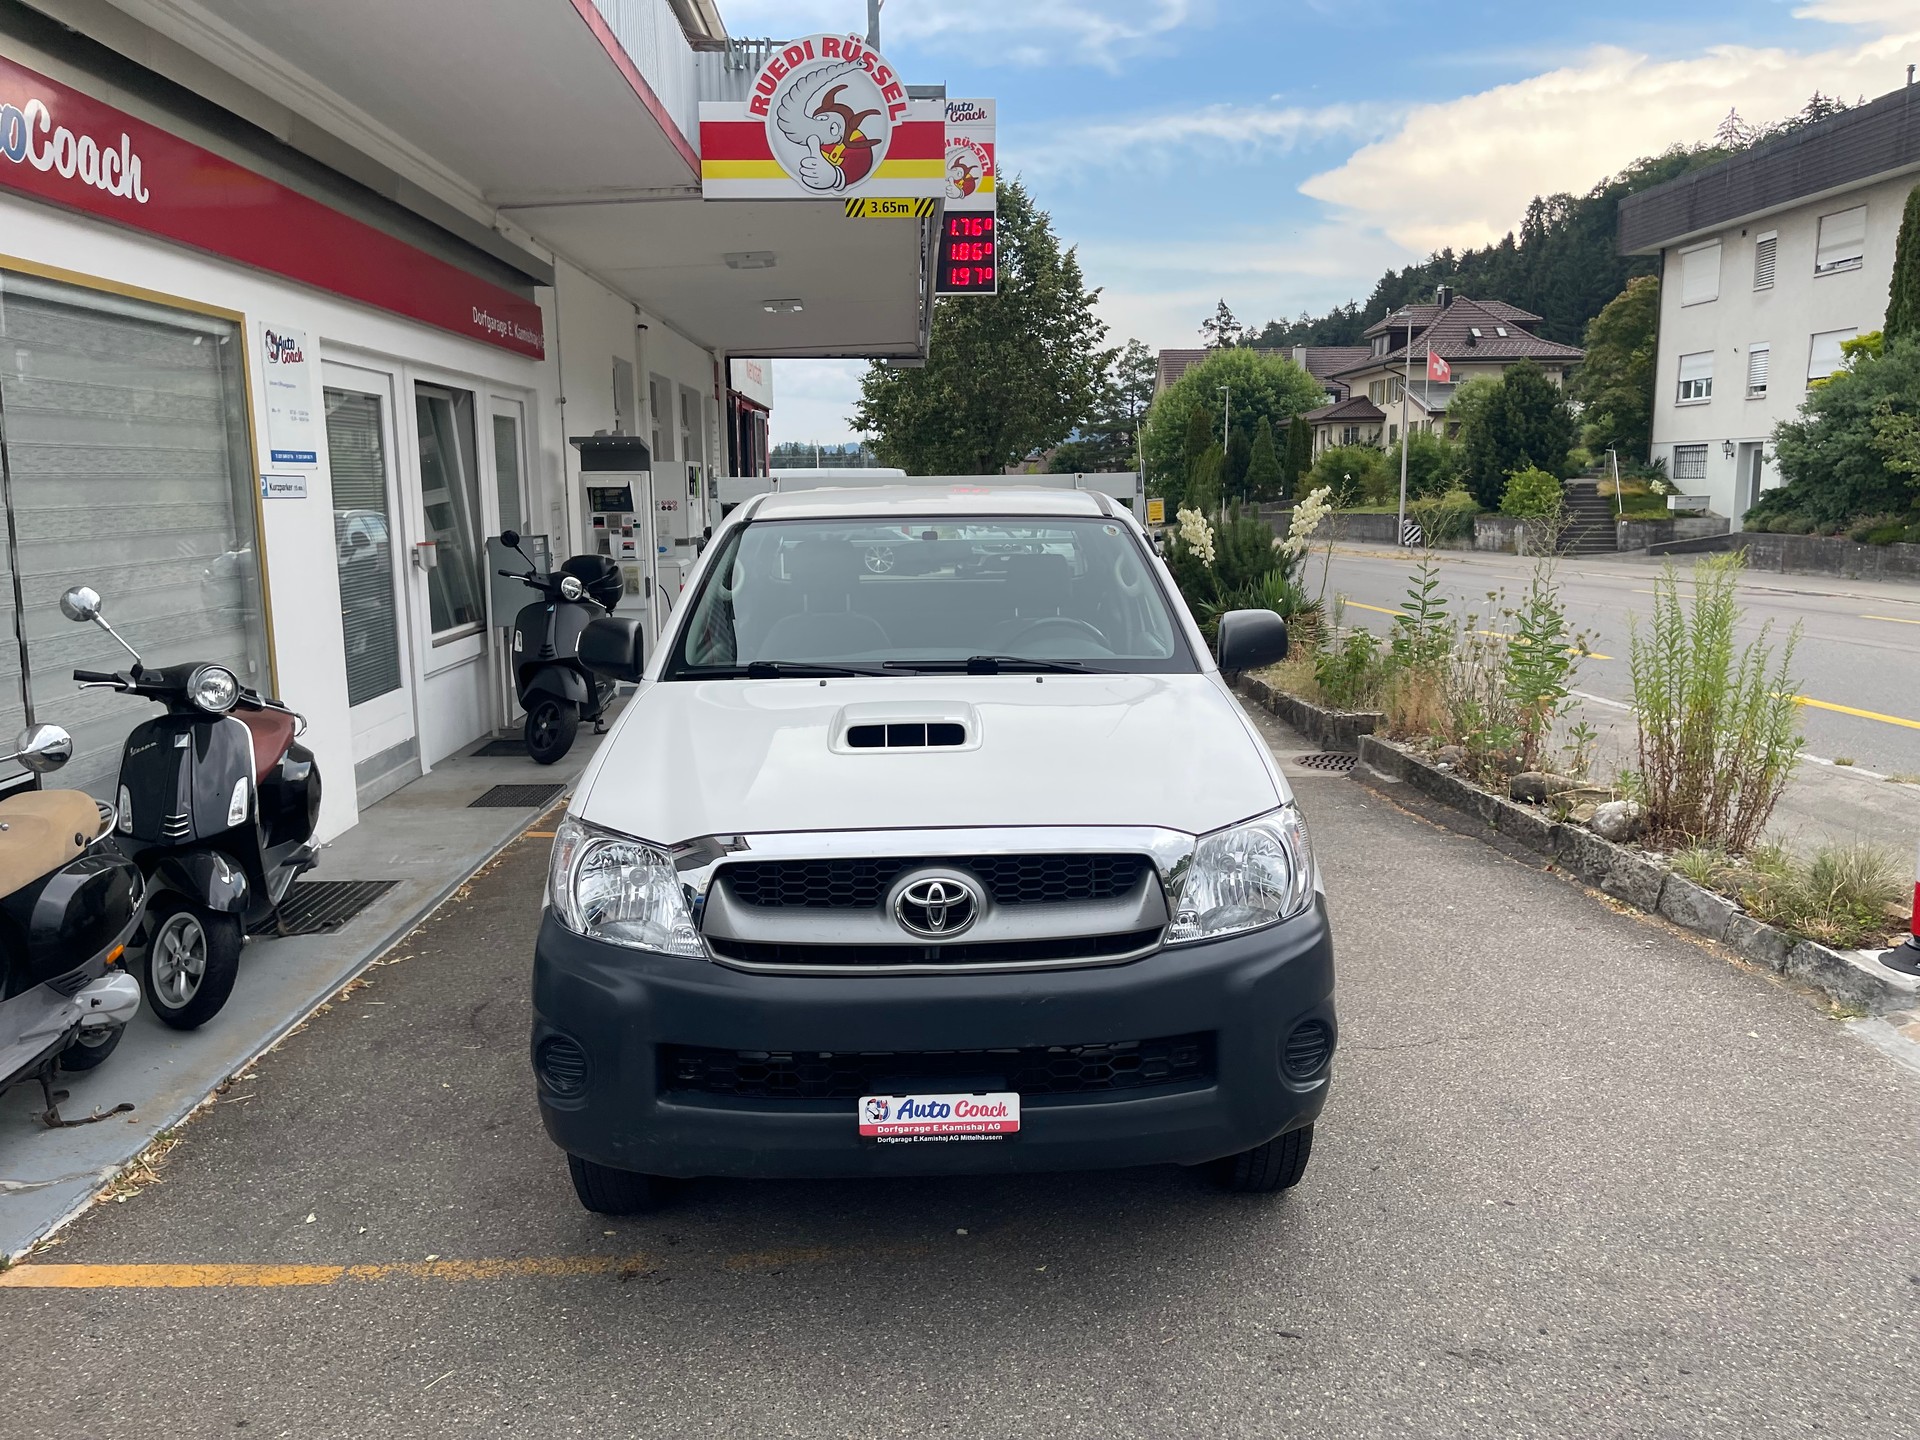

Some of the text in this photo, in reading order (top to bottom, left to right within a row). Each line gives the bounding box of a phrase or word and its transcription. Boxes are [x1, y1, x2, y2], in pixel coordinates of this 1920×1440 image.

[750, 35, 907, 121] RUEDI RÜSSEL
[945, 102, 974, 118] Auto
[950, 108, 987, 122] Coach
[954, 136, 989, 170] RÜSSEL
[871, 201, 909, 213] 3.65m
[278, 335, 295, 350] Auto
[281, 347, 304, 364] Coach
[897, 1099, 1008, 1120] Auto Coach
[877, 1126, 931, 1134] Dorfgarage
[877, 1136, 912, 1144] Dorfgarage
[960, 1134, 1002, 1142] Mittelhäusern
